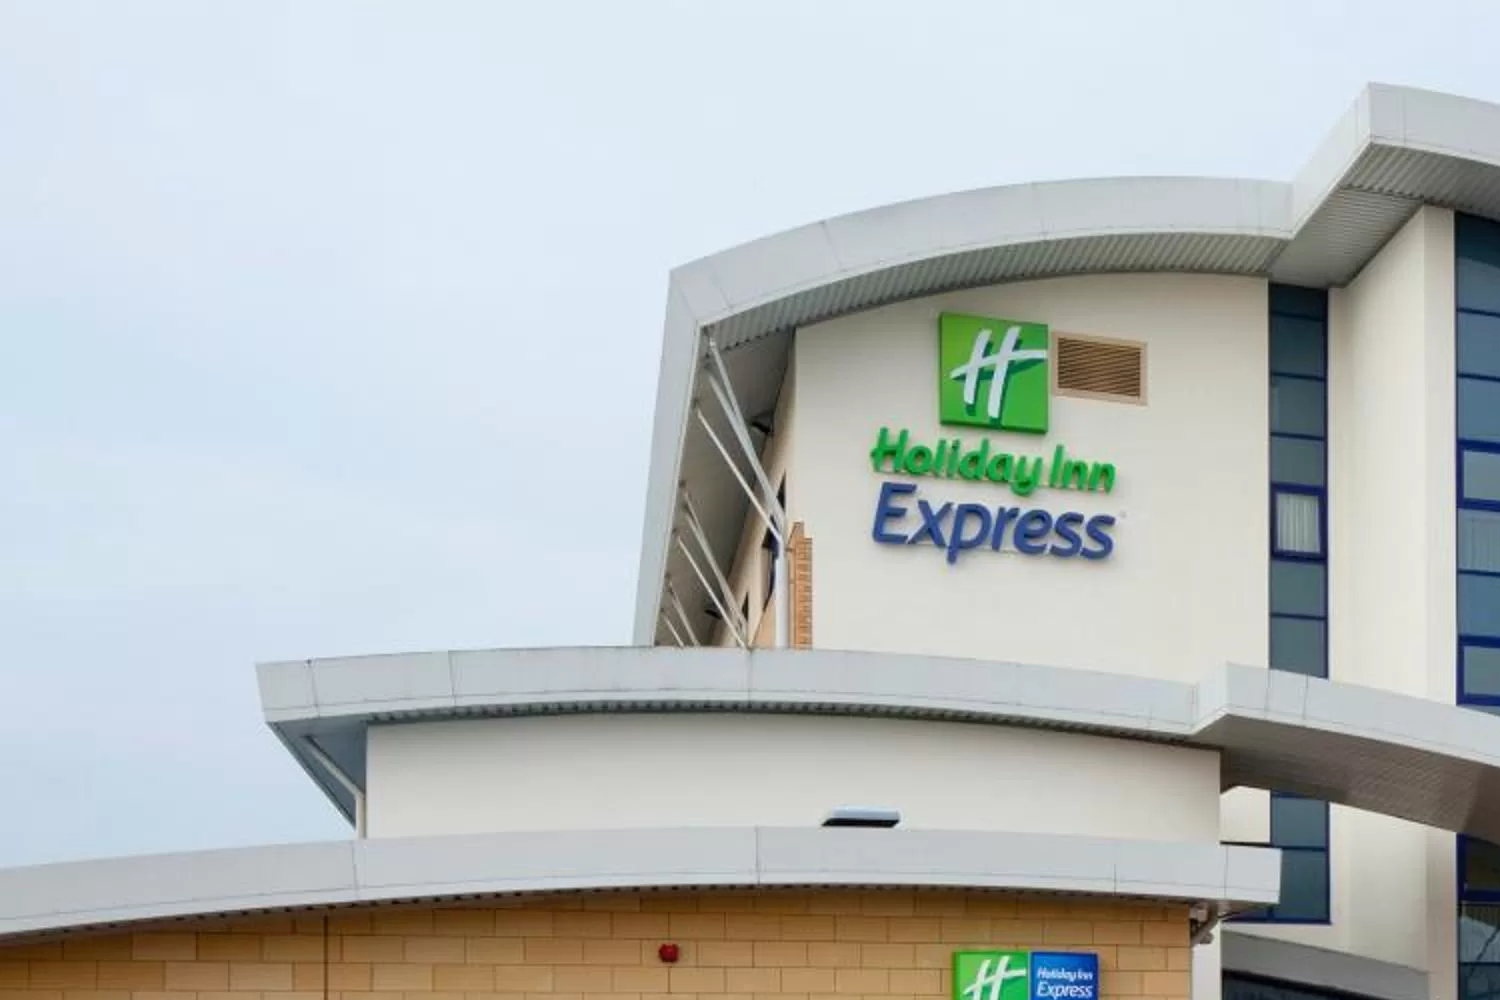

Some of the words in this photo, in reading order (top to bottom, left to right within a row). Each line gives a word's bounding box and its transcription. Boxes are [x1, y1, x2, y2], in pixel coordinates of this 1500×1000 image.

[870, 426, 1043, 497] Holiday
[1048, 444, 1117, 495] Inn
[872, 481, 1117, 565] Express
[1037, 967, 1077, 982] Holiday
[1037, 981, 1094, 1000] Express
